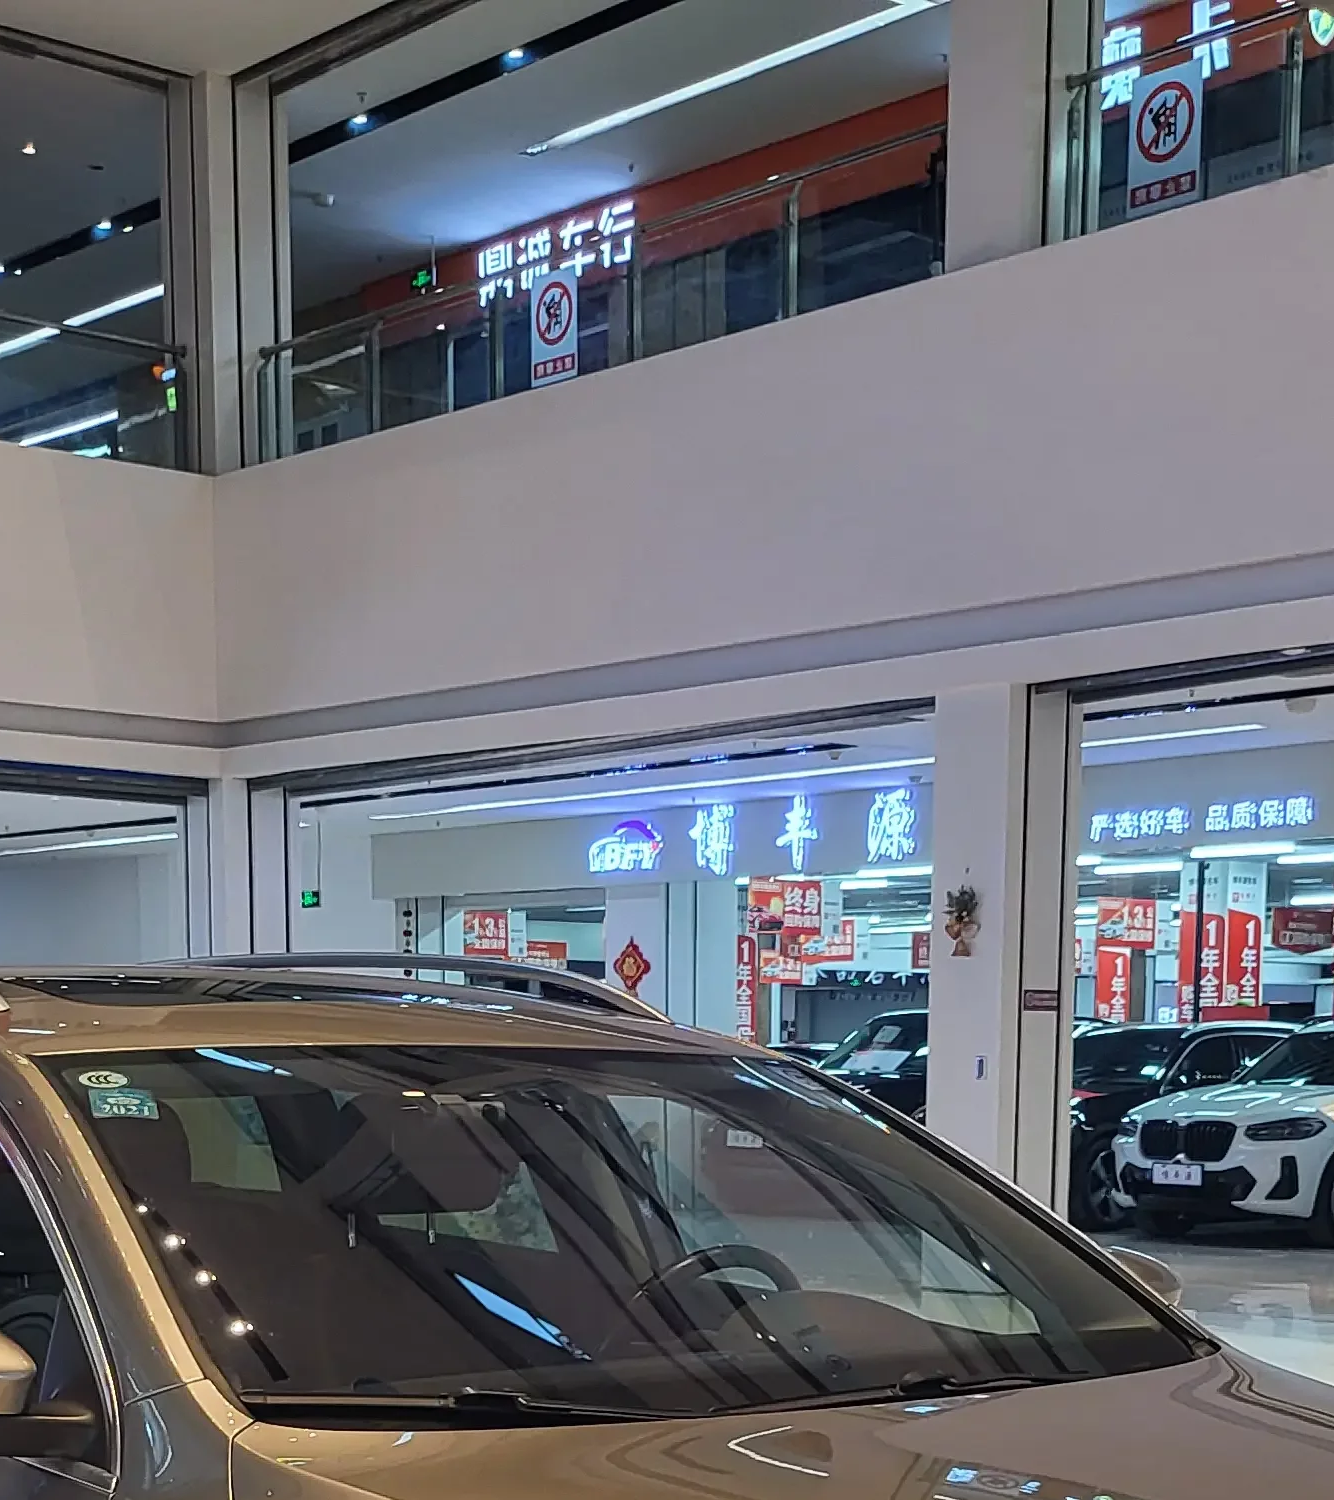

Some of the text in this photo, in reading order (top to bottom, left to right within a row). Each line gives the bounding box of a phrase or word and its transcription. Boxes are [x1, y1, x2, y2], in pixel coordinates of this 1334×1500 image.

[1088, 795, 1318, 843] 严选好车 品质保障
